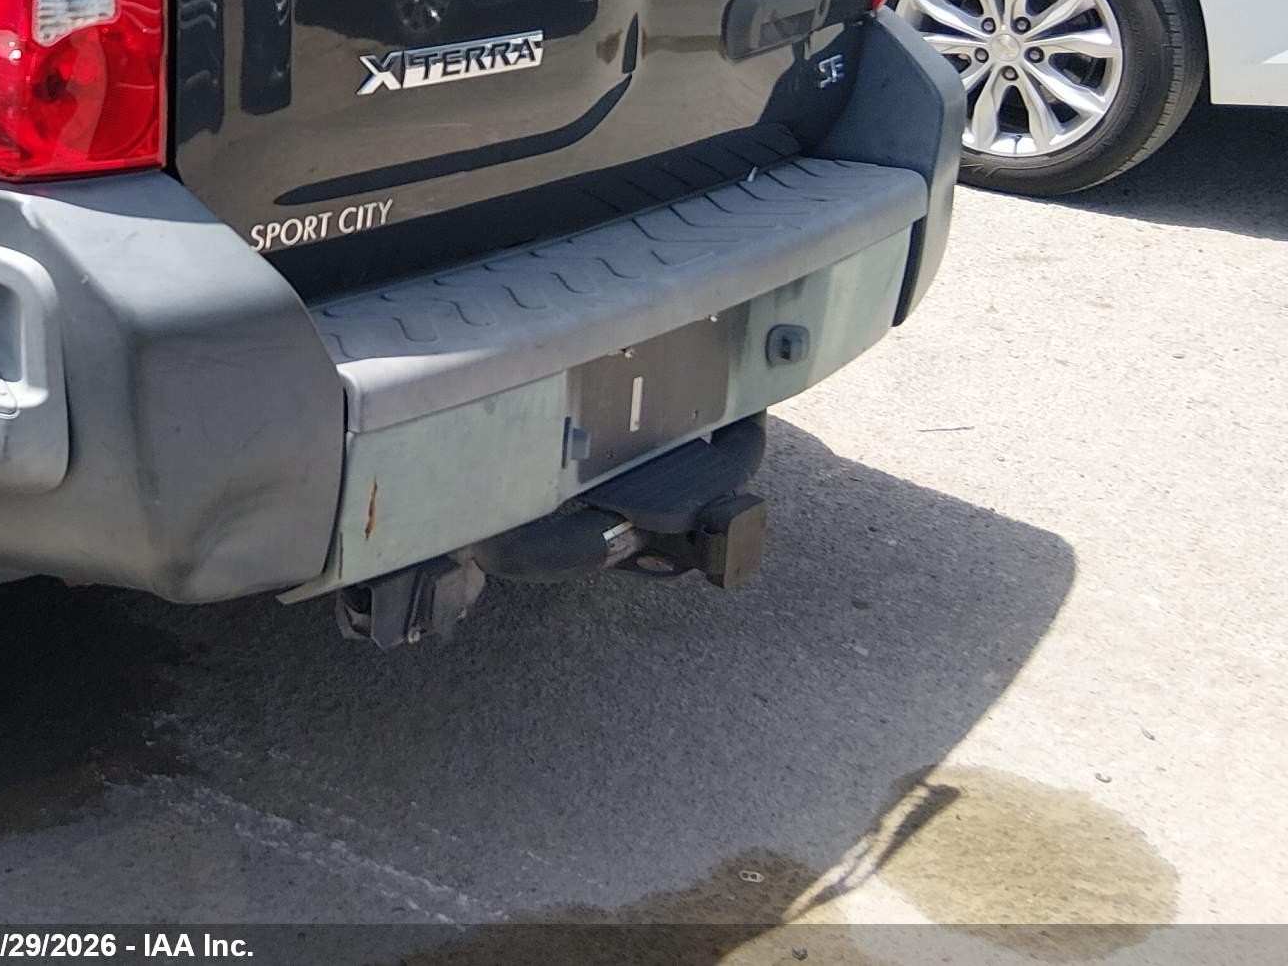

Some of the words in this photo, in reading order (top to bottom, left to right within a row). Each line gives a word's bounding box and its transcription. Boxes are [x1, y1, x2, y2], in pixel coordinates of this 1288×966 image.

[356, 30, 544, 96] XTERRA
[250, 211, 334, 252] SPORT
[338, 198, 394, 235] CITY
